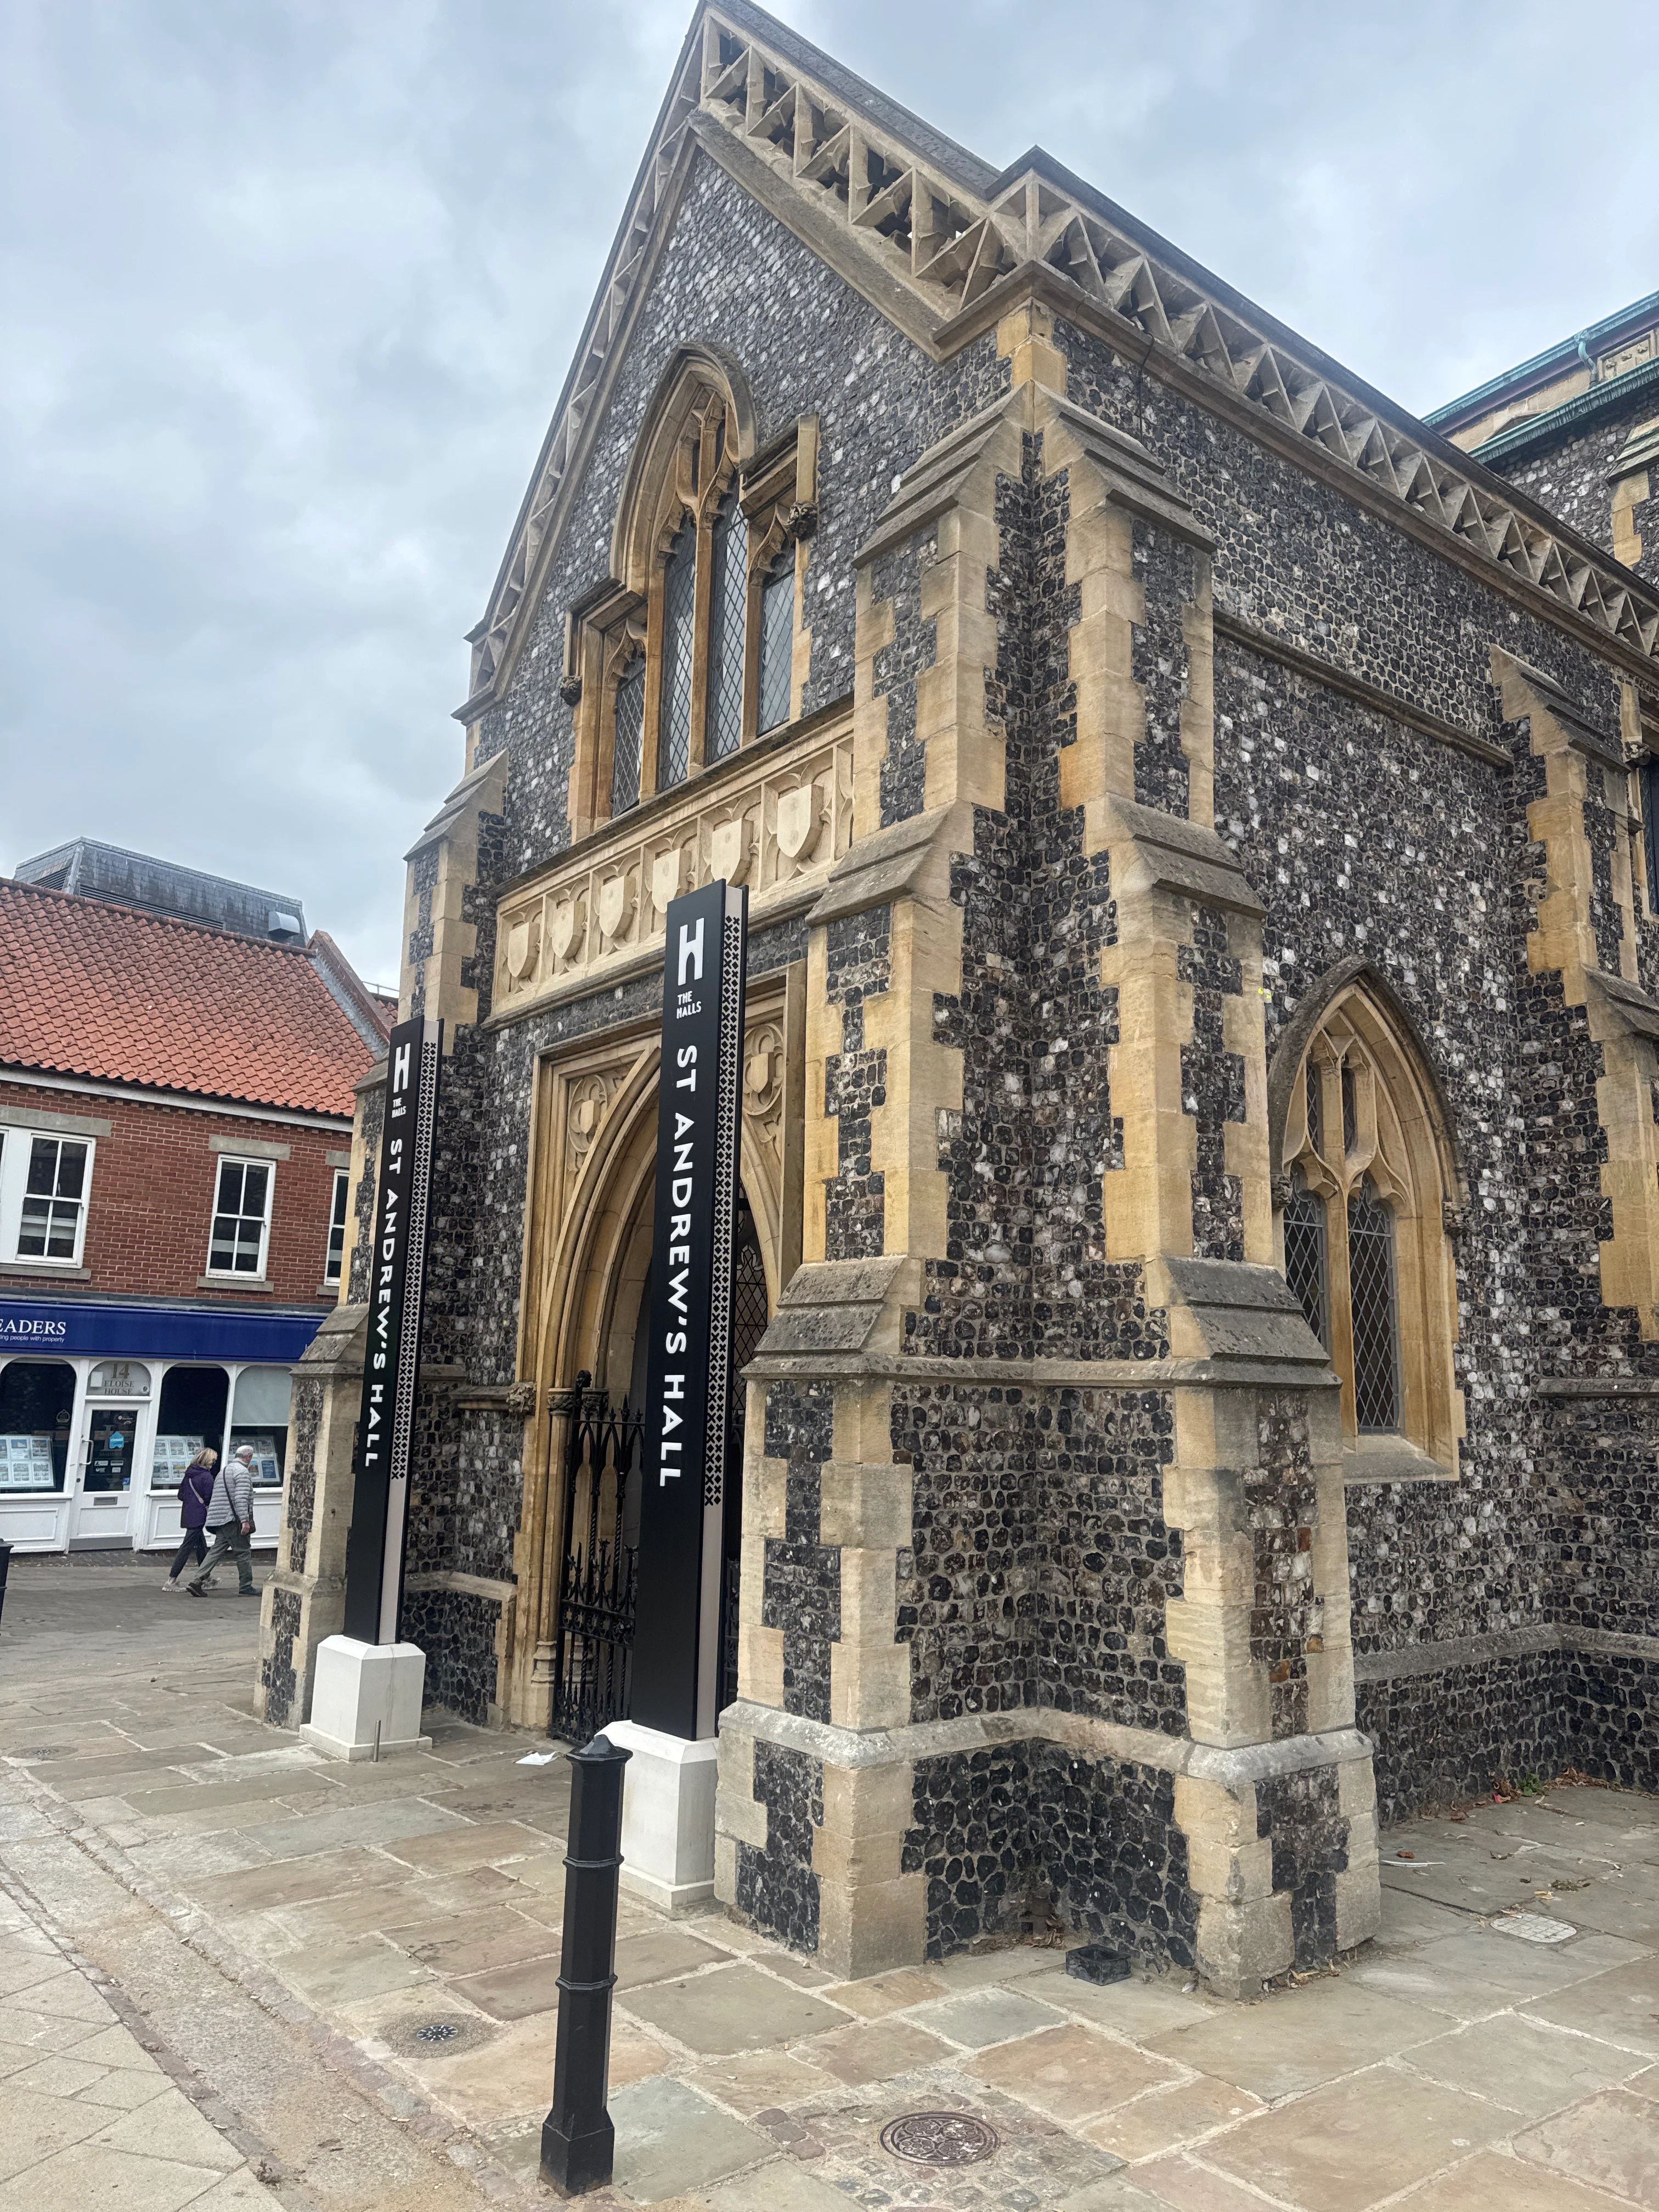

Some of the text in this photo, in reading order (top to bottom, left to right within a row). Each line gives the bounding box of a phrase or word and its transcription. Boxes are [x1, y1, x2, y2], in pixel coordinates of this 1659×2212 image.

[677, 990, 693, 1006] THE
[676, 1001, 702, 1019] HALLS
[392, 1097, 402, 1108] THE
[391, 1105, 407, 1119] HALLS
[659, 1045, 698, 1487] ST ANDREW'S HALL
[365, 1138, 403, 1468] ST ANDREW'S HALL
[111, 1363, 129, 1379] 14
